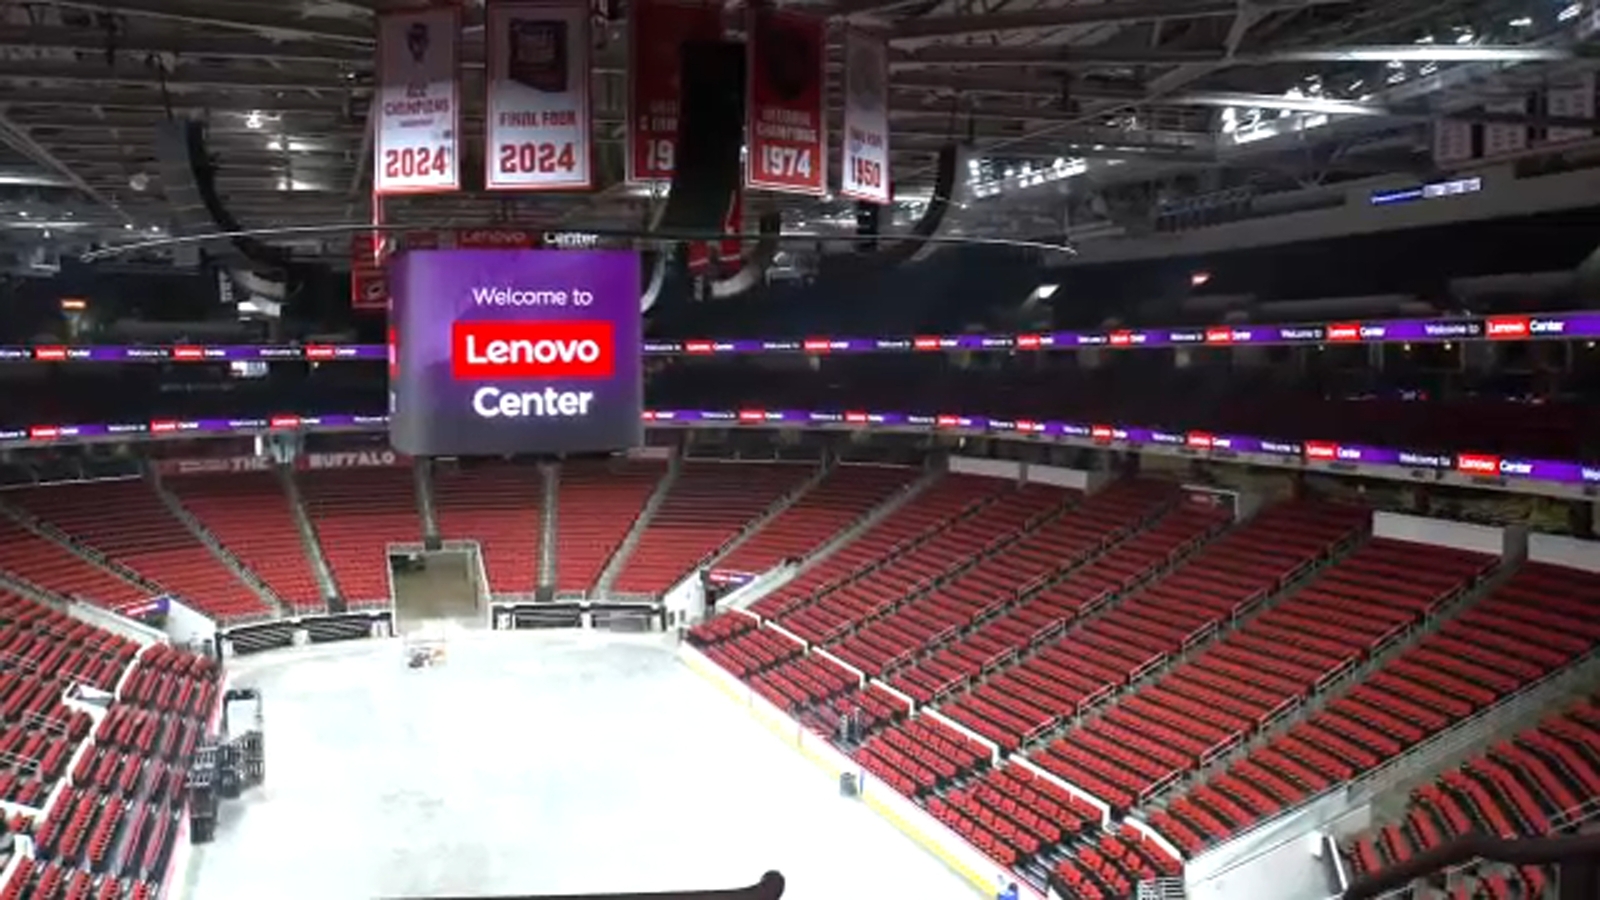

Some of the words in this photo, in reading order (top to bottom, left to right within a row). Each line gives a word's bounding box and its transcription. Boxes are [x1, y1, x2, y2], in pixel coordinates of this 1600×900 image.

[499, 111, 539, 126] FINAL
[541, 110, 577, 126] FOUR
[385, 146, 447, 178] 2024
[500, 142, 577, 174] 2024
[646, 139, 676, 171] 19
[762, 144, 811, 178] 1974
[543, 231, 600, 247] Center
[471, 286, 568, 306] Welcome
[572, 288, 594, 306] to
[1488, 322, 1526, 333] Lenovo
[1530, 320, 1564, 332] Center
[465, 334, 601, 365] Lenovo
[472, 386, 594, 417] Center
[308, 451, 396, 470] BUFFALO
[1459, 456, 1496, 470] Lenovo
